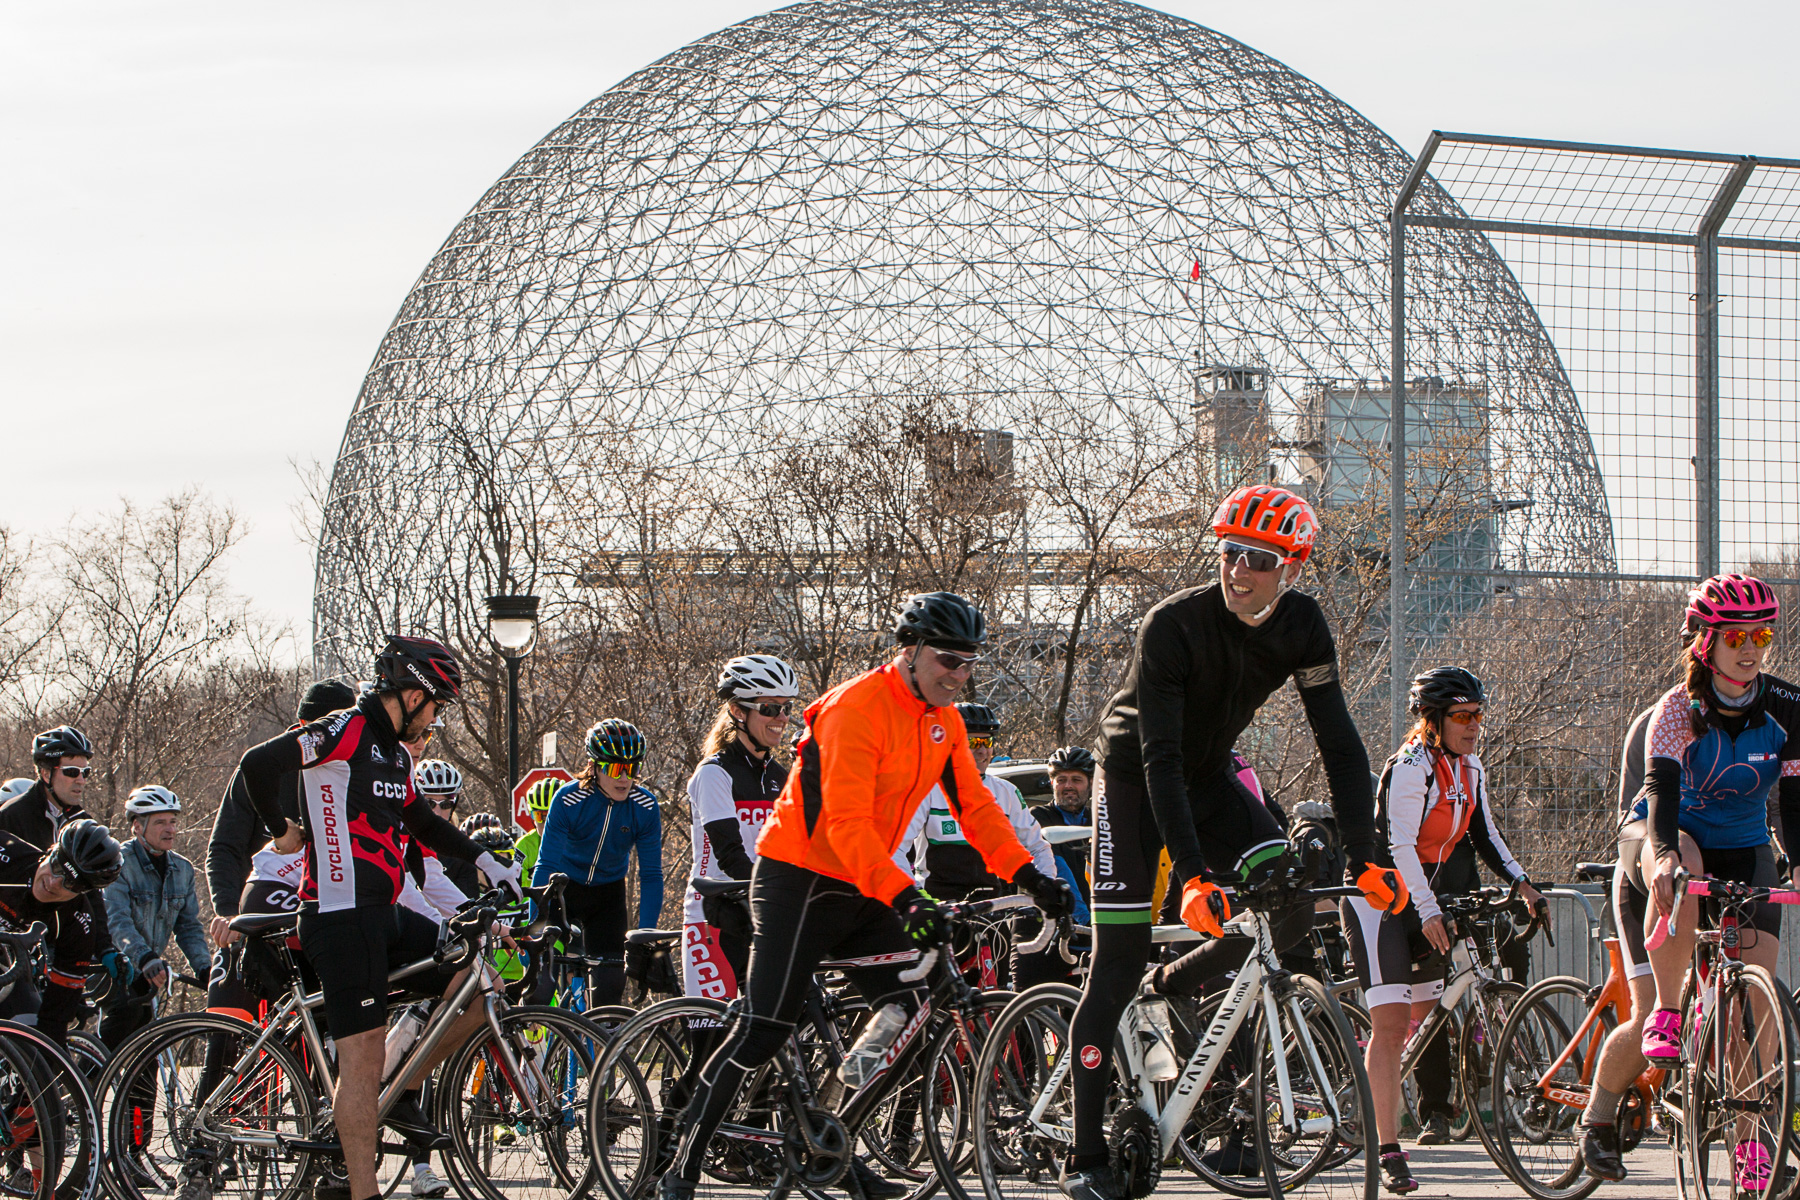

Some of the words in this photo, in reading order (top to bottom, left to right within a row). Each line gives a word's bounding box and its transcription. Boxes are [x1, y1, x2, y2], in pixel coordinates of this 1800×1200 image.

[406, 663, 437, 695] DIADORA
[320, 784, 344, 883] CYCLEPOP.CA
[1097, 778, 1114, 876] momentum
[63, 861, 79, 879] RAPHA
[685, 925, 727, 999] CCCP
[885, 1000, 931, 1066] TIME
